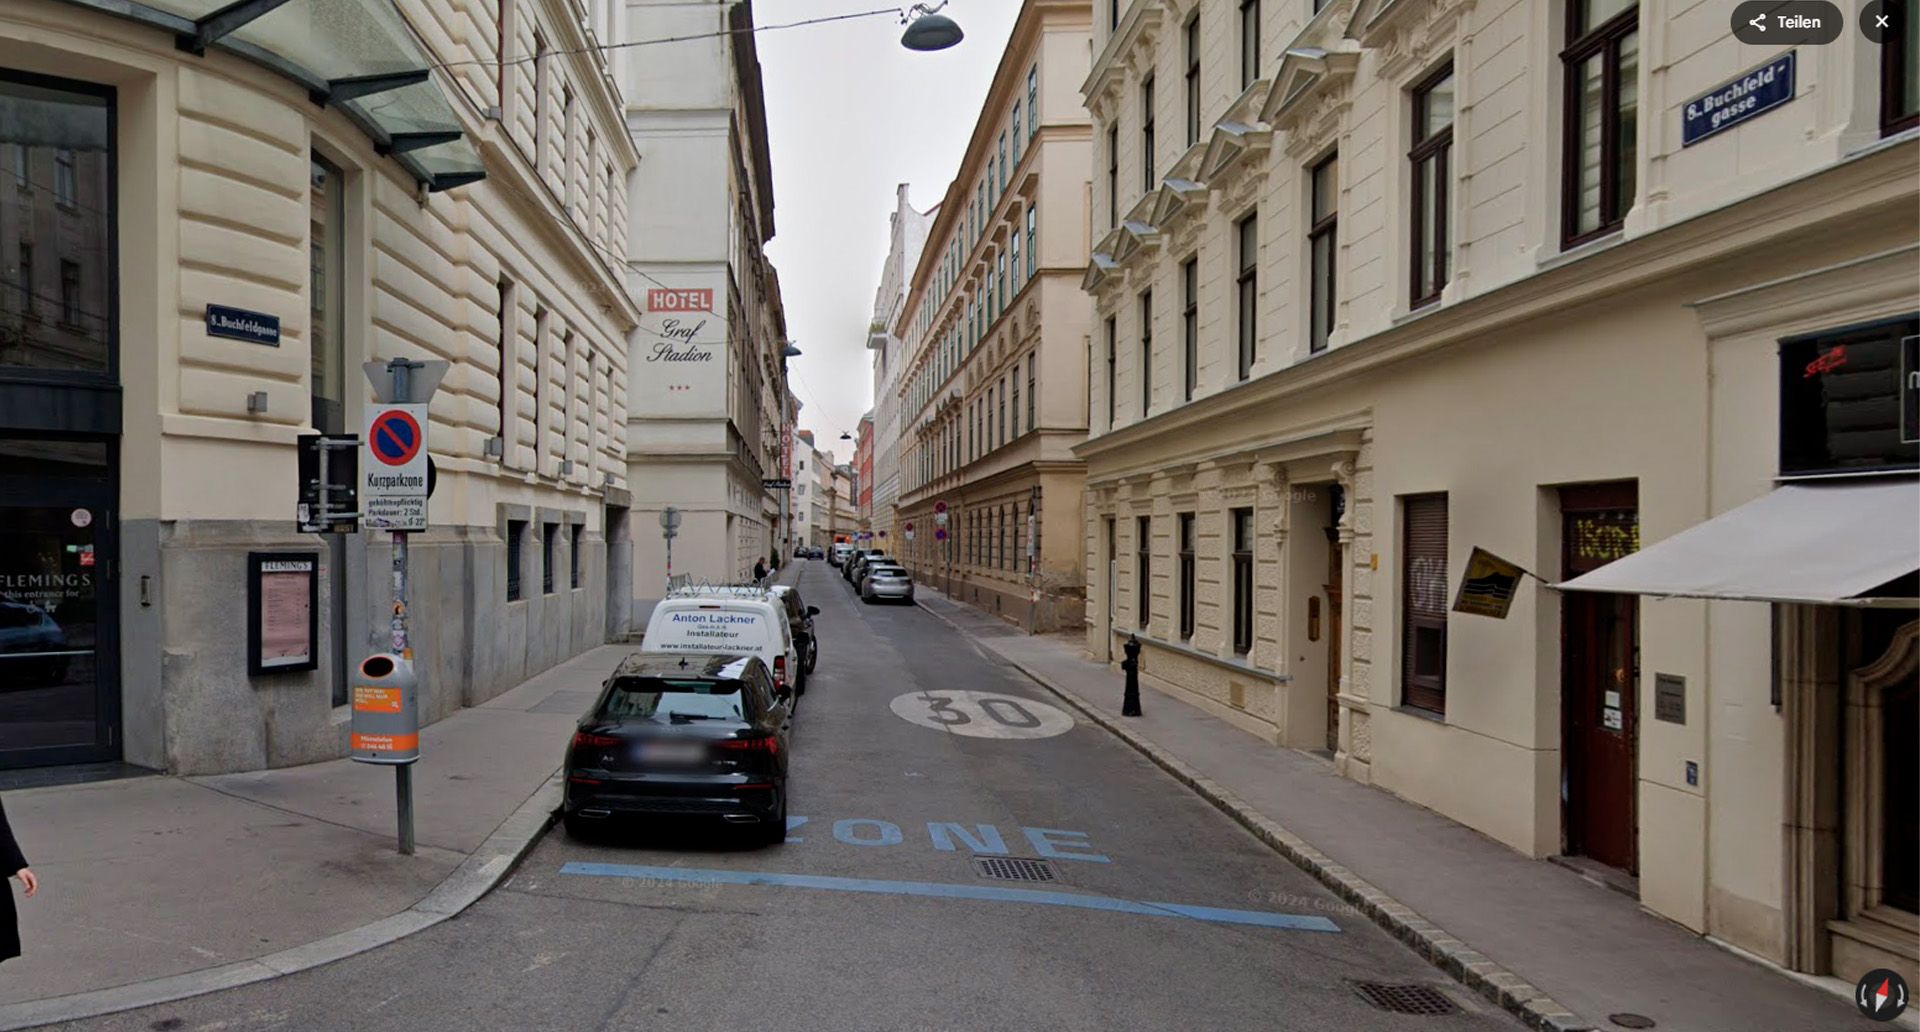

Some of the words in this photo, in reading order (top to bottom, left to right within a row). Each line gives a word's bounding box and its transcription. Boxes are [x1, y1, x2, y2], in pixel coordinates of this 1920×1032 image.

[1711, 95, 1757, 127] gasse
[653, 292, 710, 309] HOTEL
[660, 319, 706, 344] Graf
[646, 342, 713, 362] Stadion
[781, 423, 791, 478] HOTEL
[368, 473, 423, 490] Kurzparkzone
[65, 588, 79, 597] for
[672, 613, 707, 622] Anton
[710, 614, 756, 624] Lackner
[687, 630, 739, 638] Installateur
[660, 642, 763, 652] www.installateur-lackner.at
[917, 696, 1042, 729] 30
